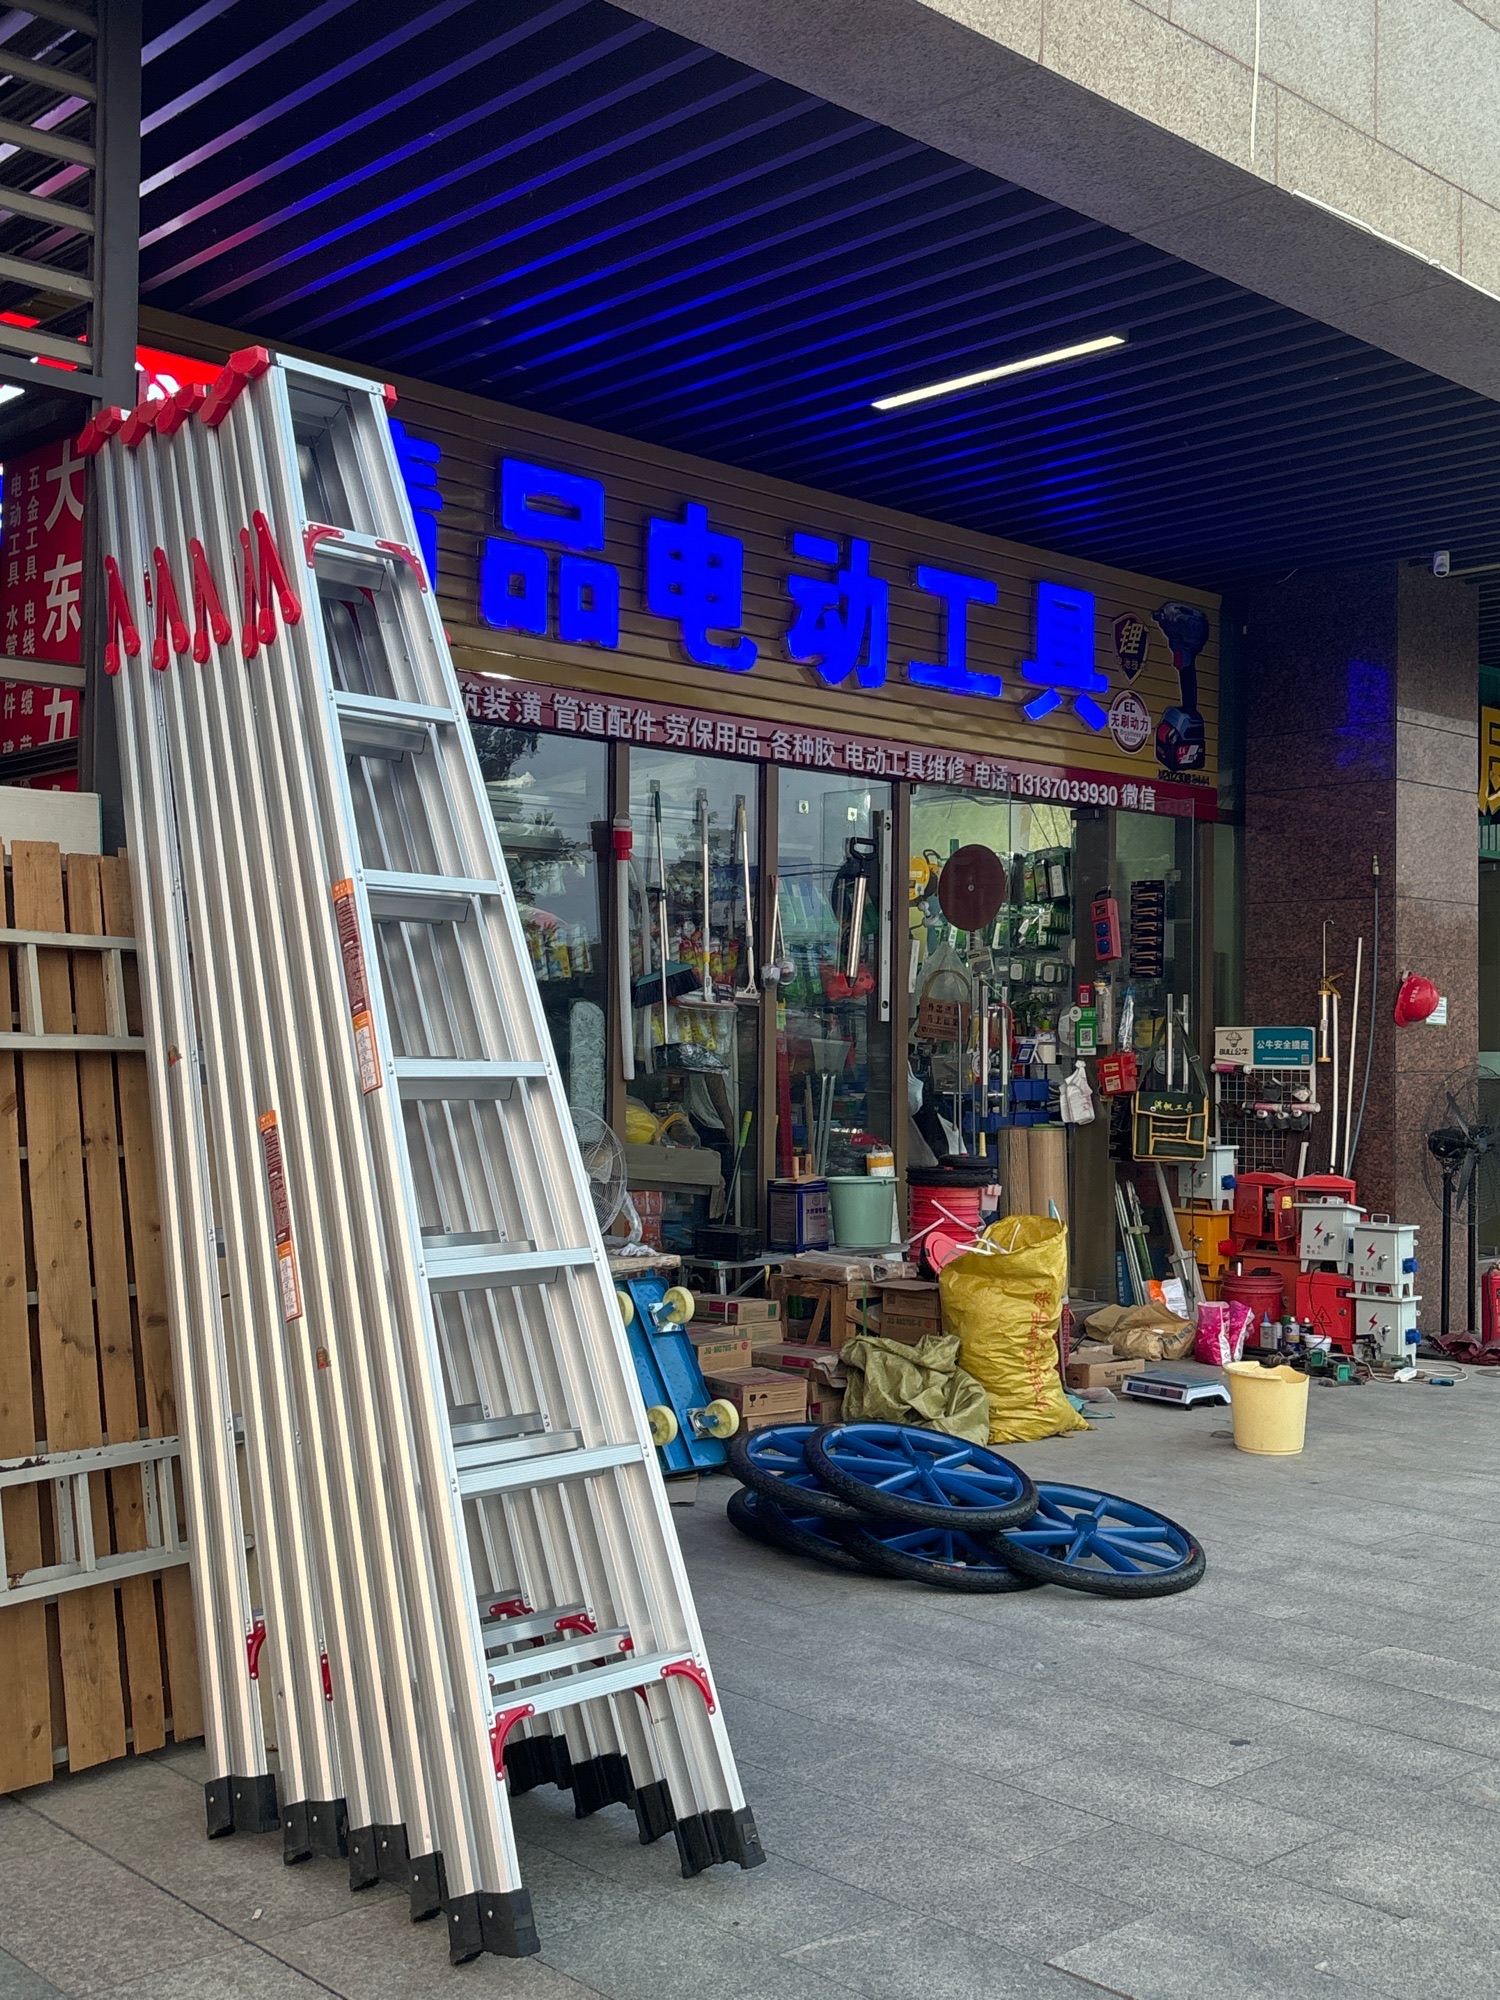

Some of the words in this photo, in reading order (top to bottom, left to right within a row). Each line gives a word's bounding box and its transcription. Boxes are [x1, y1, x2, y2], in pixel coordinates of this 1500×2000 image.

[7, 473, 22, 588] 电动工具
[25, 465, 41, 583] 五金工具
[21, 599, 37, 715] 电线缆
[1118, 620, 1143, 655] 锂
[553, 692, 656, 742] 管道配件
[665, 713, 761, 758] 劳保用品
[770, 729, 836, 768] 各种胶
[845, 741, 965, 785] 电动工具维修
[1121, 783, 1156, 812] 微信
[1111, 713, 1149, 731] 无刷动力
[1124, 702, 1136, 713] EC
